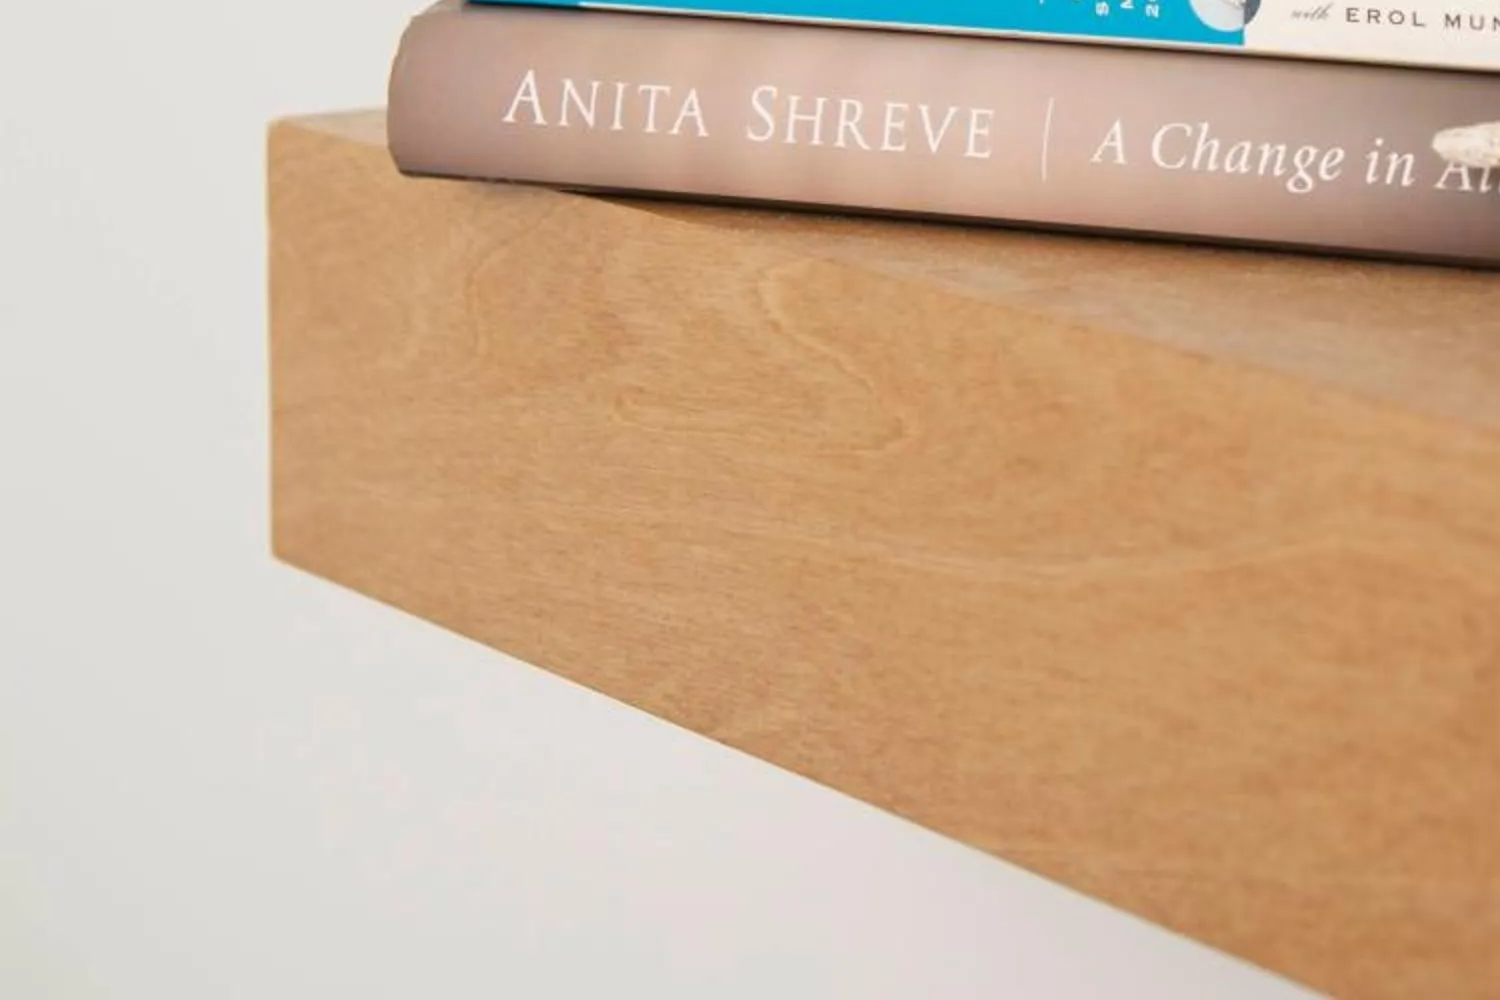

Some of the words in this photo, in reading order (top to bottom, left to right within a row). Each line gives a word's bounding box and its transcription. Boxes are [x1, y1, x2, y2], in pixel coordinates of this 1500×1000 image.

[1290, 2, 1333, 21] with
[1345, 7, 1426, 28] EROL
[502, 69, 710, 138] ANITA
[746, 85, 996, 159] SHREVE
[1090, 117, 1128, 165] A
[1150, 121, 1345, 193] Change
[1364, 137, 1416, 187] in
